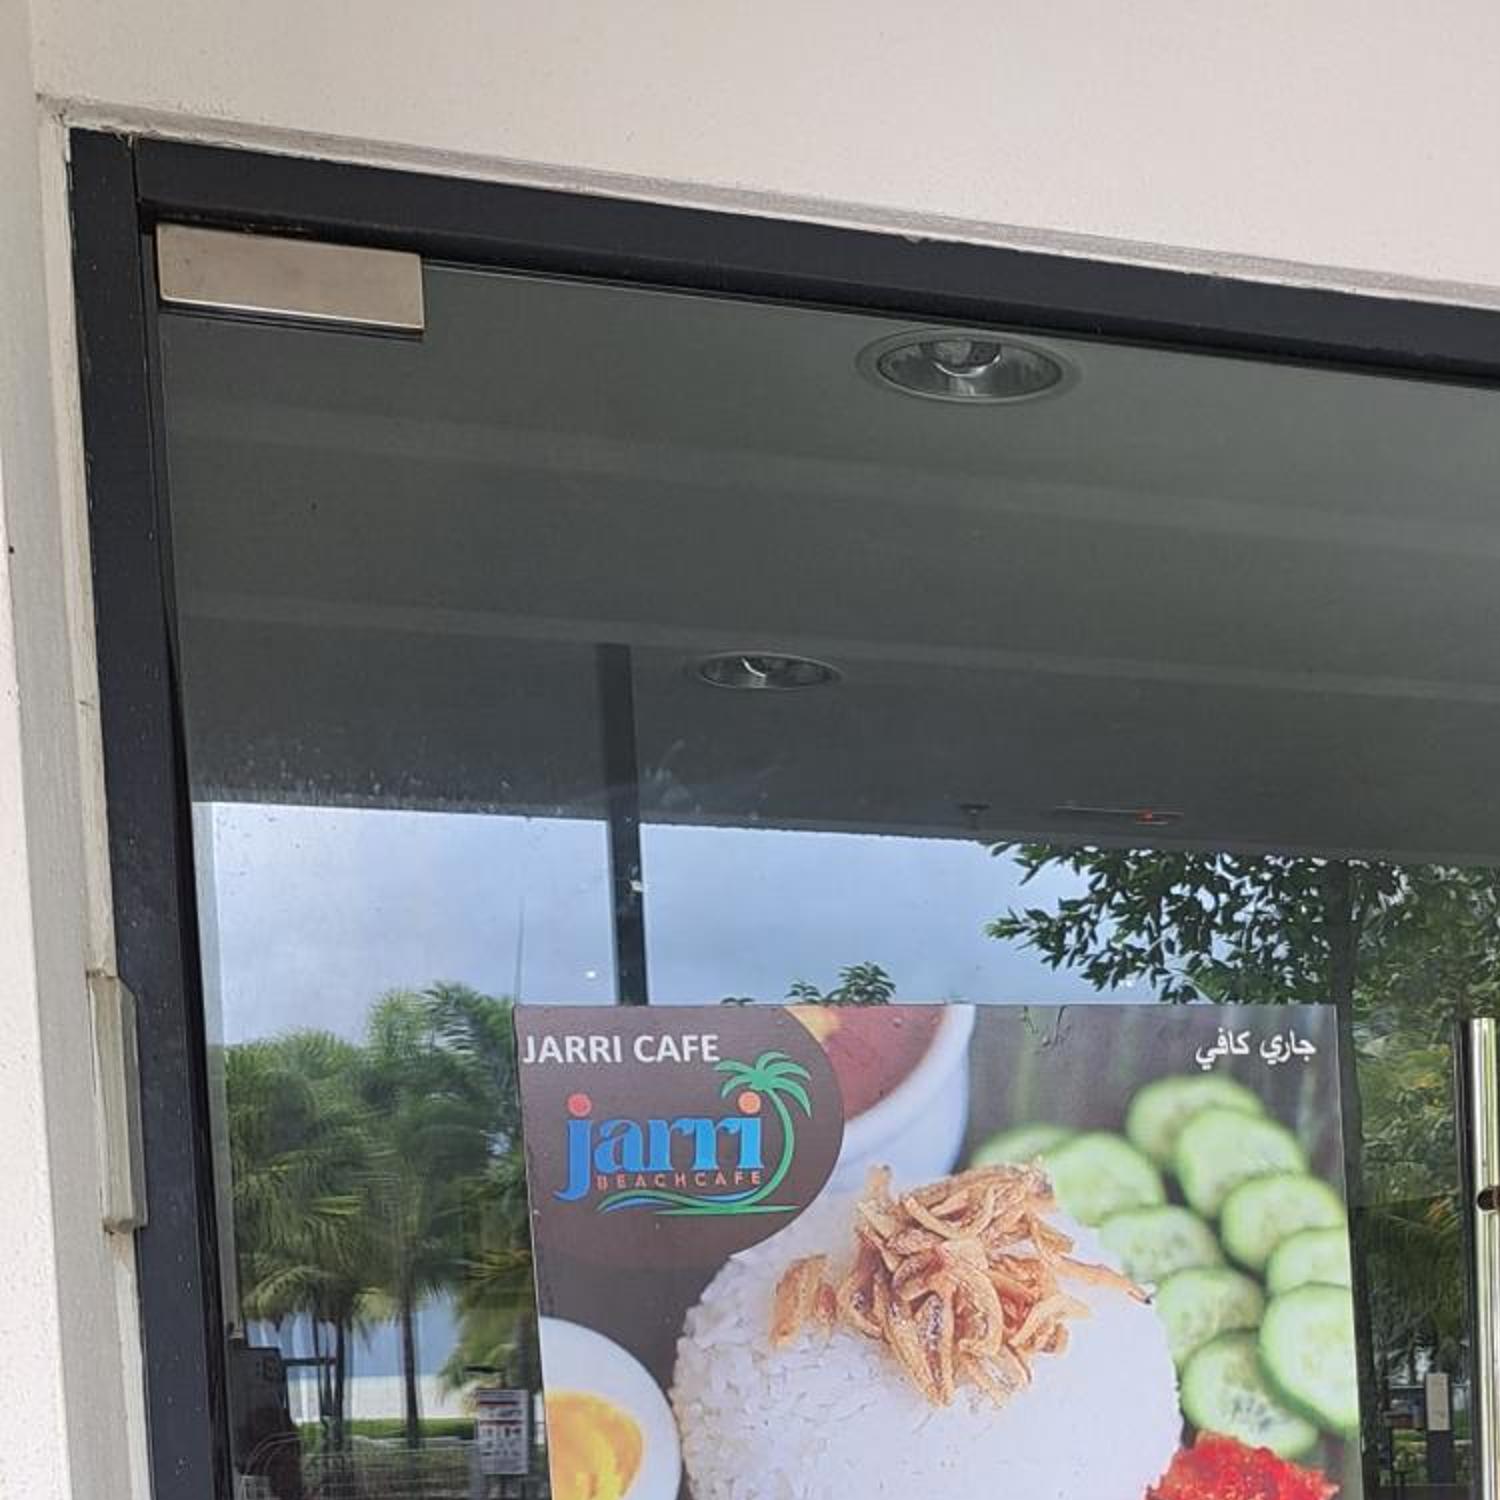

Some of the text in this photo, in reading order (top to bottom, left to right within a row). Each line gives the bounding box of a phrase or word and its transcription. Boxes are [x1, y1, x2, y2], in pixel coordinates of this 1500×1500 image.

[523, 1034, 720, 1063] JARRI CAFE
[1195, 1027, 1317, 1070] جاري كافي
[553, 1091, 765, 1200] jarri
